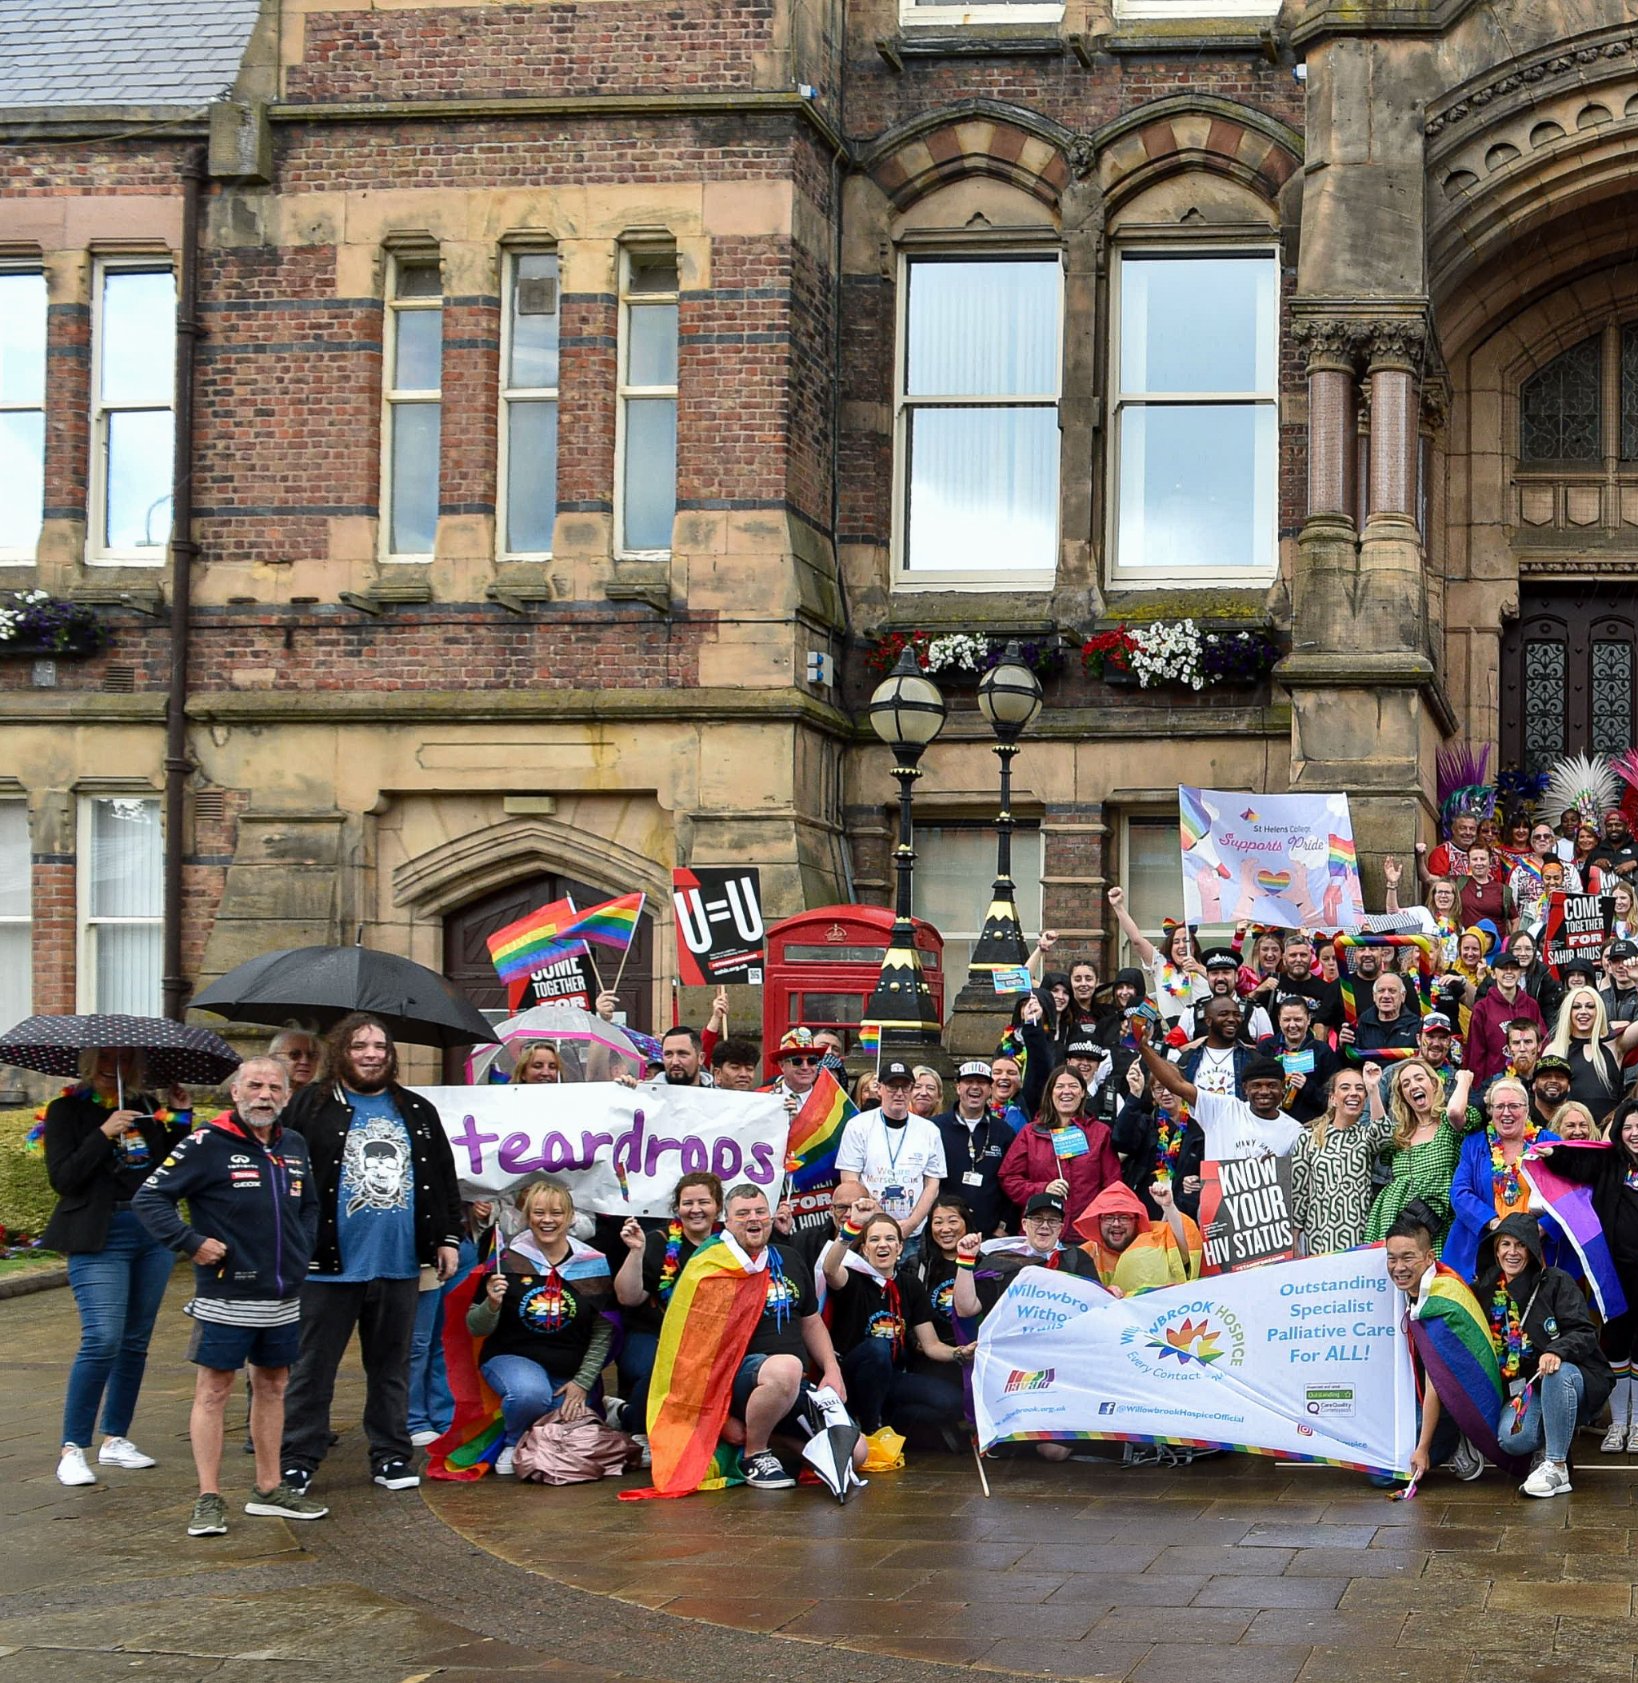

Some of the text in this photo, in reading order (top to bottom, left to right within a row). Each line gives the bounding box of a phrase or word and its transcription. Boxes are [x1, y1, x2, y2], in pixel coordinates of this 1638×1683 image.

[1253, 824, 1312, 835] St Helens College
[1219, 833, 1324, 853] Supports Pride
[673, 876, 764, 954] U=U
[1563, 895, 1603, 920] COME
[1565, 917, 1604, 933] TOGETHER
[1568, 933, 1602, 946] FOR
[1576, 945, 1602, 960] HOUS
[532, 975, 587, 999] TOGETHER
[1217, 1157, 1278, 1197] KNOW
[789, 1192, 832, 1212] FOR
[1224, 1185, 1288, 1231] YOUR
[1203, 1236, 1230, 1267] HIV
[1233, 1220, 1293, 1259] STATUS
[1279, 1275, 1388, 1296] Outstanding
[1007, 1284, 1089, 1313] Willowbro
[535, 1302, 560, 1316] 25
[1017, 1305, 1072, 1322] Witho
[1290, 1299, 1374, 1320] Specialist
[1215, 1305, 1245, 1367] HOSPICE
[1266, 1322, 1396, 1342] Palliative Care
[1290, 1345, 1371, 1363] For ALL!
[1126, 1351, 1153, 1374] Every
[1152, 1367, 1201, 1381] Contact
[1117, 1405, 1245, 1424] @WillowbrookHospiceOfficial
